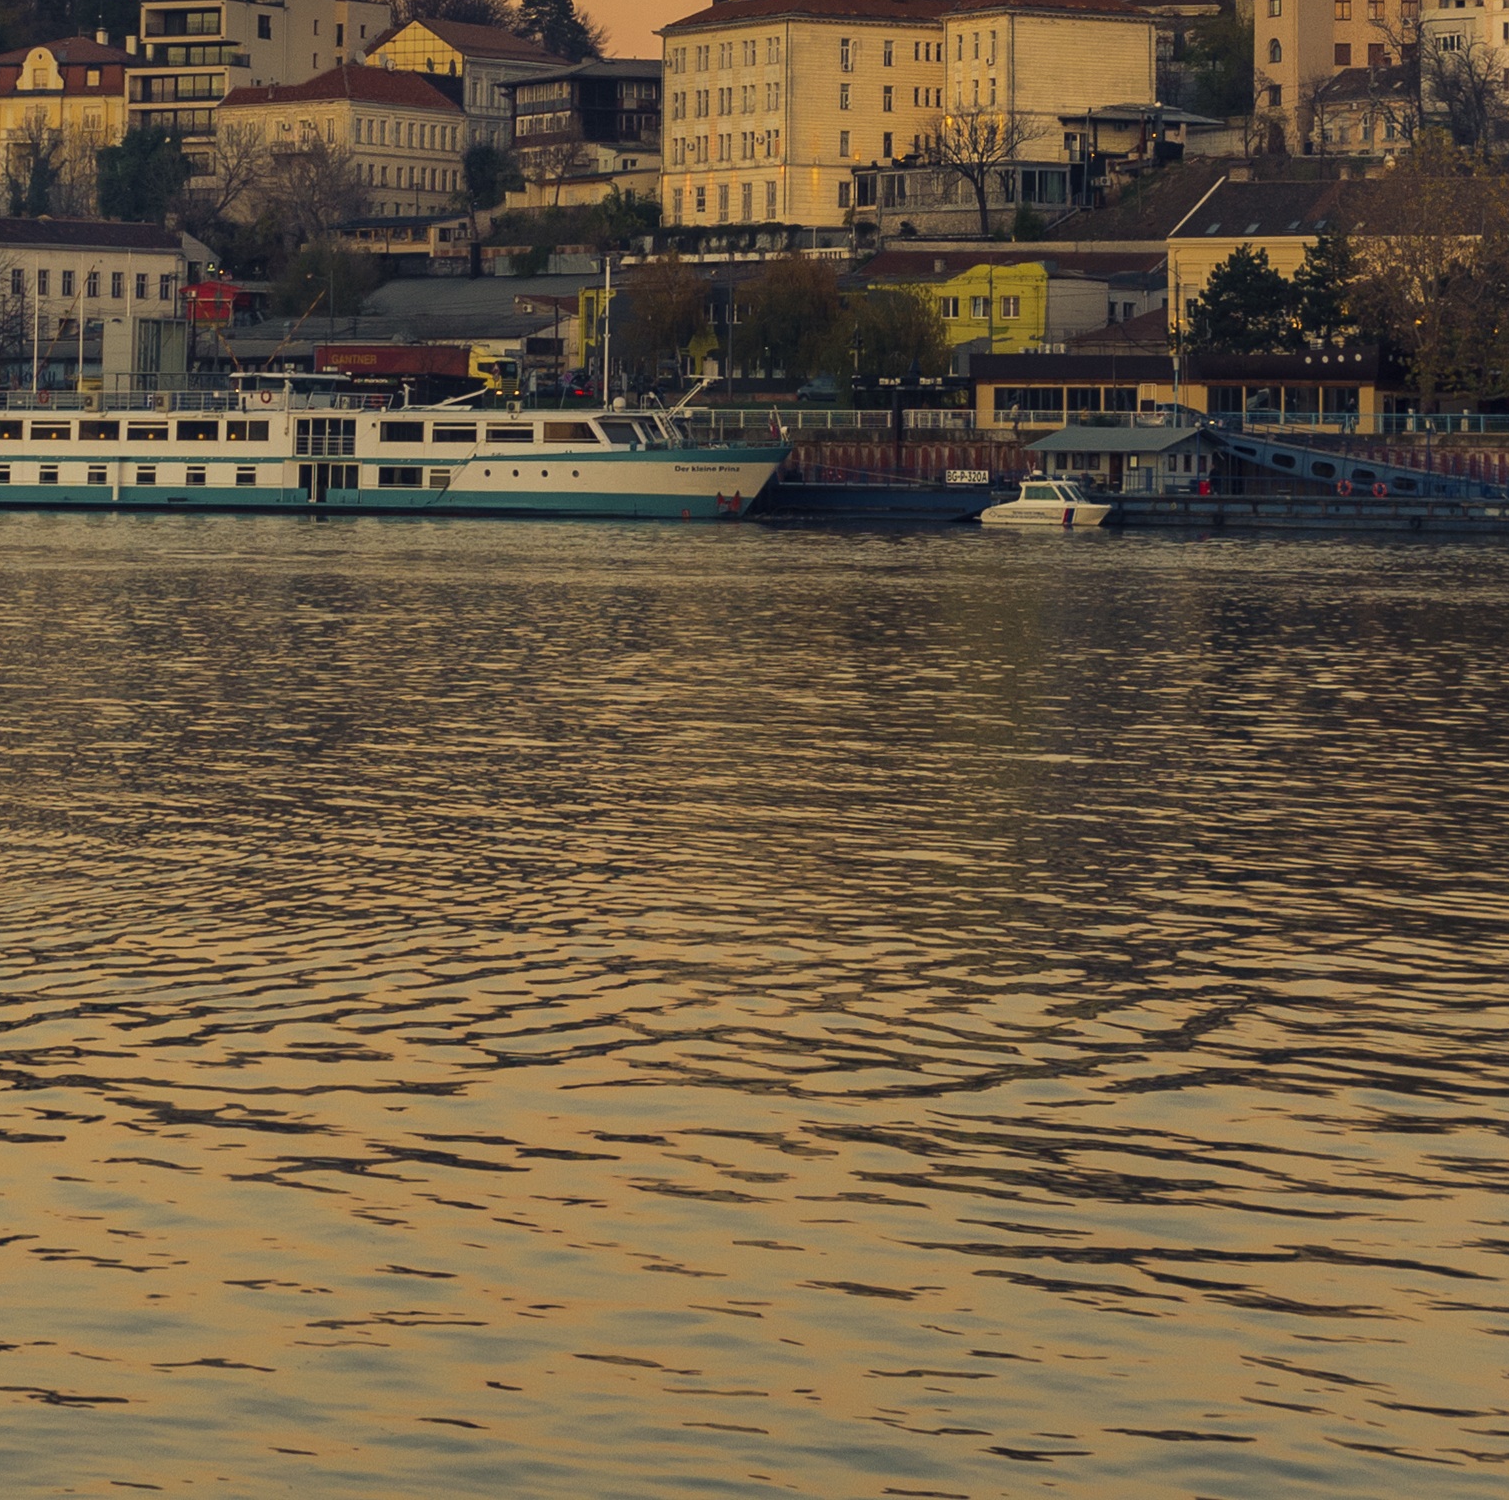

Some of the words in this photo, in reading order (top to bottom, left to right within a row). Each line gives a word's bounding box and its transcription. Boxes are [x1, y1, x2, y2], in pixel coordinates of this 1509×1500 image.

[331, 354, 377, 365] GANTNER
[674, 465, 689, 473] Der
[691, 465, 717, 473] kleine
[719, 465, 740, 473] Prinz
[947, 471, 988, 482] BG-P-320A
